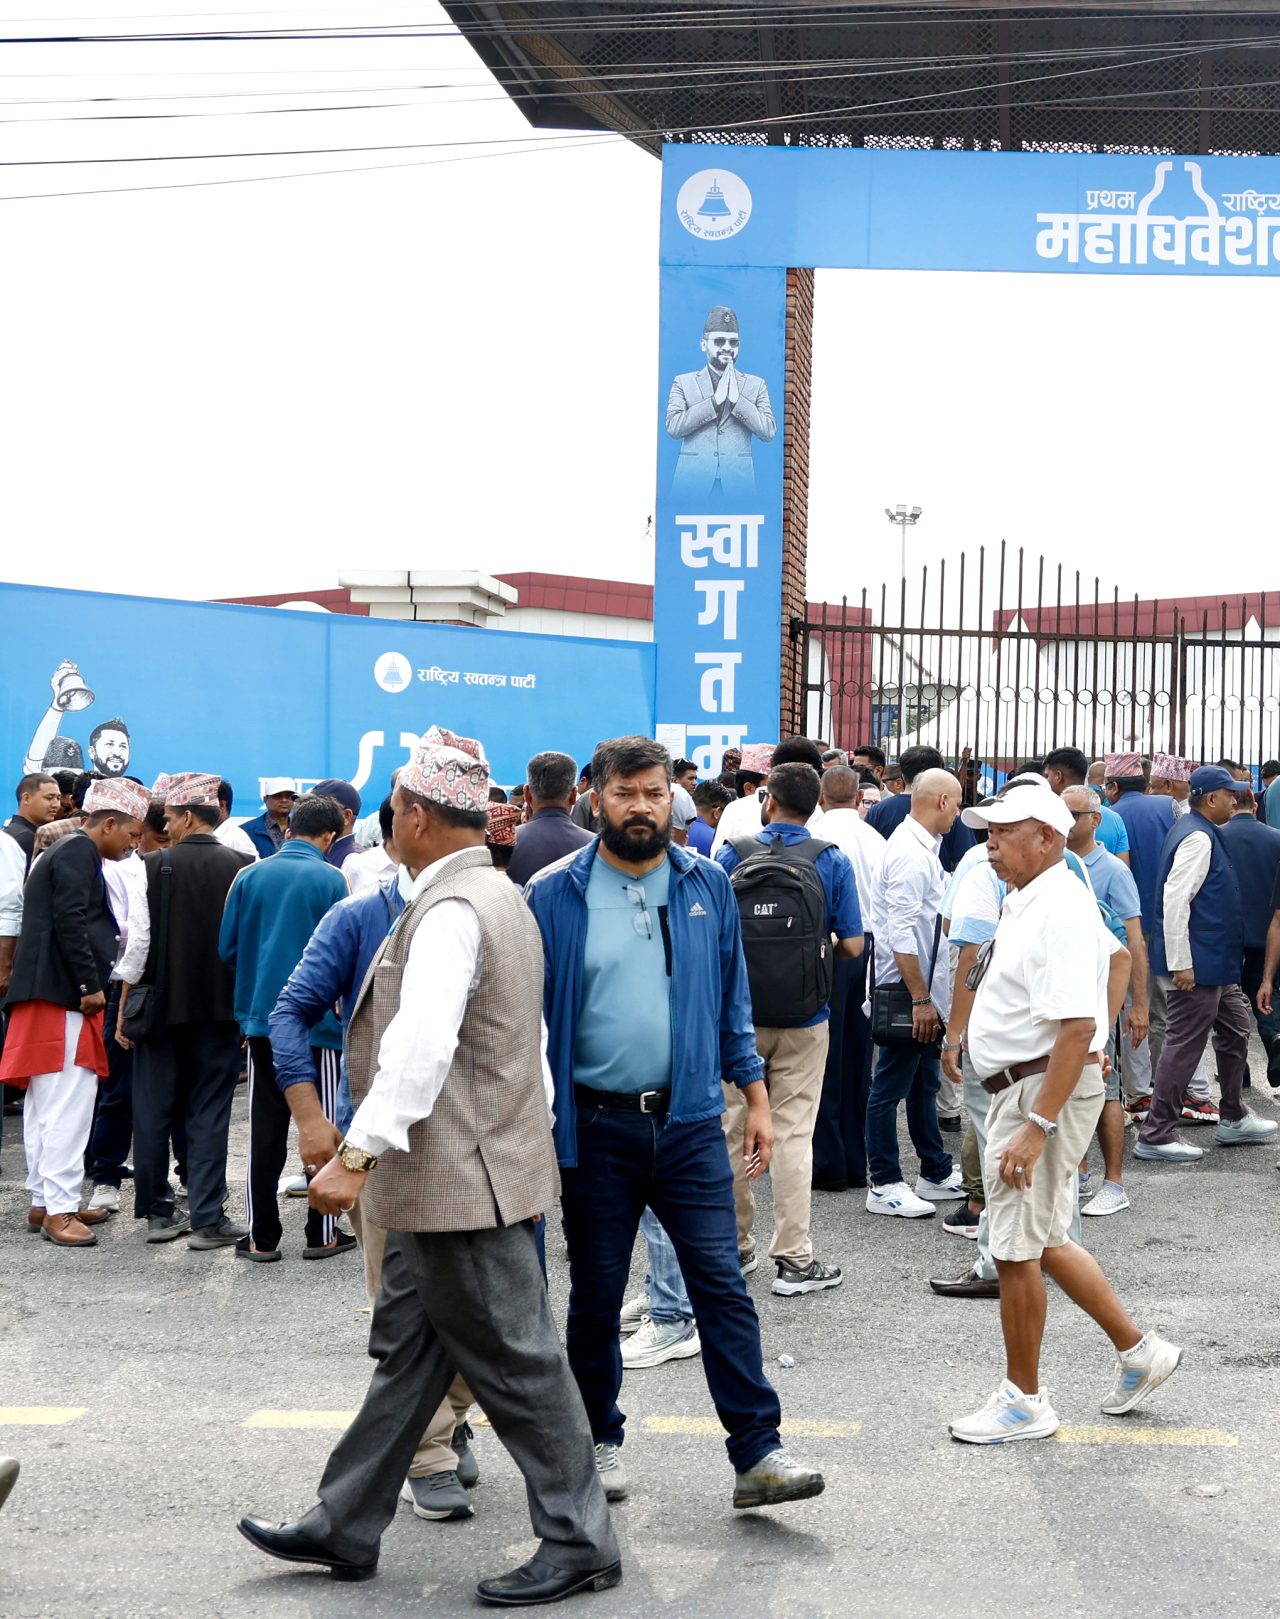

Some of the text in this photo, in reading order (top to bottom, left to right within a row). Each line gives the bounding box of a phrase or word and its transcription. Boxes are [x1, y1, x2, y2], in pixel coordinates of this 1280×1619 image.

[1085, 190, 1137, 210] प्रथम
[417, 665, 537, 689] राष्ट्रिय स्वतन्त्र पार्टी
[753, 903, 775, 916] CAT
